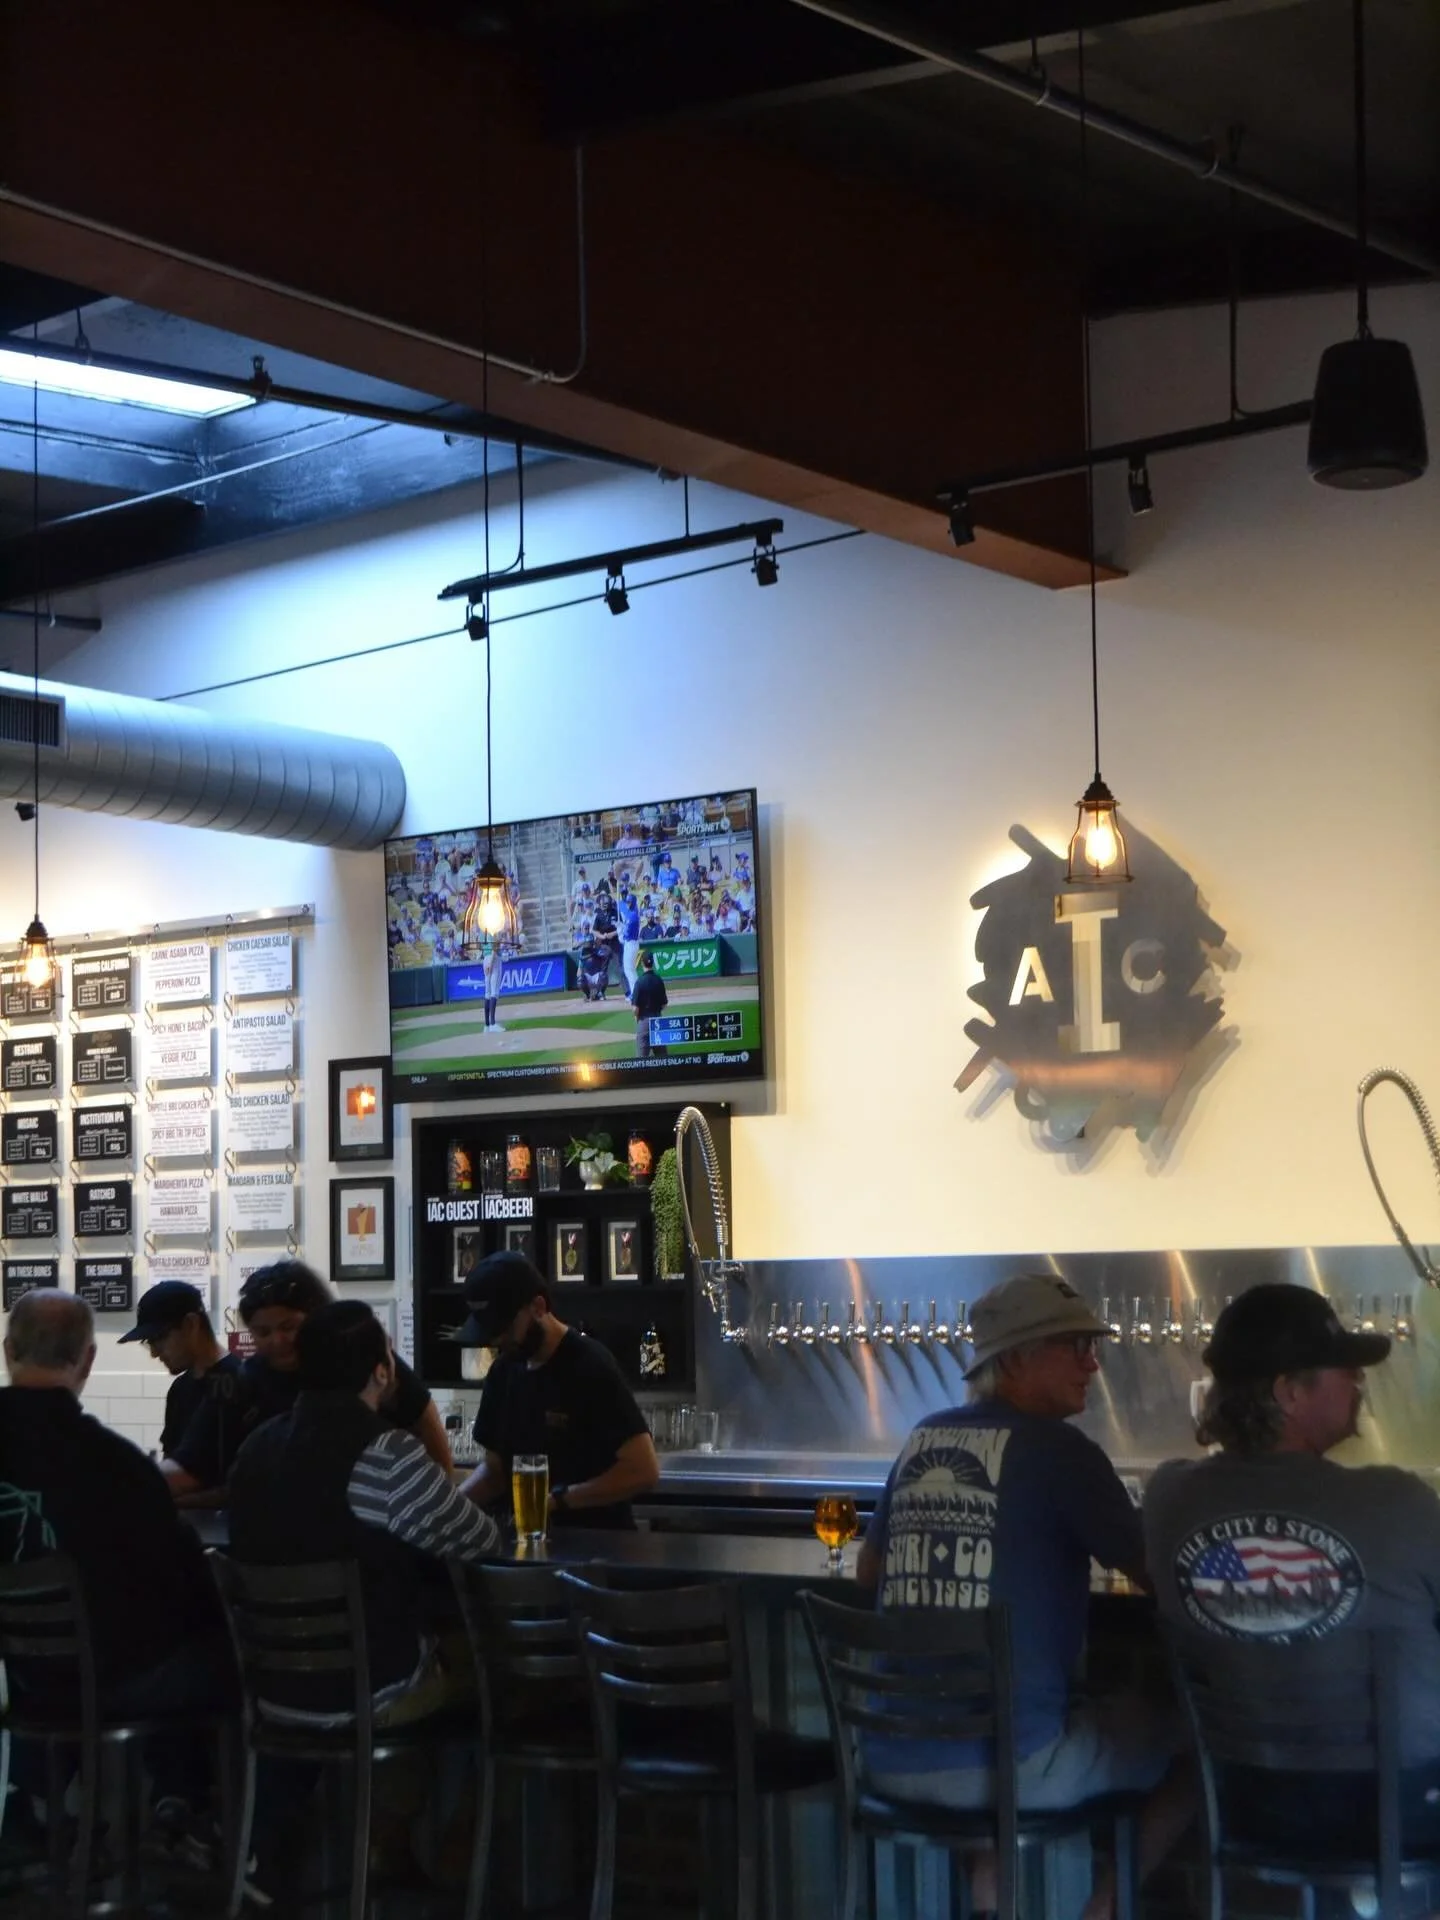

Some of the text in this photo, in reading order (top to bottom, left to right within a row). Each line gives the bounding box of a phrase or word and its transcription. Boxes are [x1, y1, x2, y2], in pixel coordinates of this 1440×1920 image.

[676, 823, 720, 836] SPORTSNET
[228, 940, 250, 952] CHICKEN
[272, 935, 290, 947] SALAD
[188, 946, 204, 956] PIZZA
[185, 976, 200, 986] PIZZA
[500, 968, 534, 989] ANA
[233, 1014, 286, 1029] ANTIPASTO SALAD
[669, 1019, 681, 1028] SEA
[168, 1023, 186, 1033] HONEY
[669, 1033, 682, 1041] LAD
[181, 1050, 196, 1061] PIZZA
[707, 1053, 741, 1064] SPORTSNET
[487, 1070, 514, 1079] SPECTRUM
[514, 1067, 545, 1077] CUSTOMERS
[546, 1066, 560, 1074] WITH
[617, 1060, 645, 1070] ACCOUNTS
[646, 1058, 667, 1068] RECEIVE
[230, 1093, 290, 1108] BBQ CHICKEN SALAD
[80, 1111, 124, 1126] INSTITUTION IPA
[192, 1127, 206, 1138] PIZZA
[189, 1178, 204, 1188] PIZZA
[262, 1174, 274, 1185] FETA
[275, 1173, 293, 1185] SALAD
[184, 1204, 198, 1216] PIZZA
[427, 1200, 480, 1222] IAC GUEST
[485, 1196, 533, 1220] IACBEER!
[172, 1256, 194, 1267] CHICKEN
[194, 1255, 209, 1266] PIZZA
[86, 1264, 96, 1276] THE
[1177, 1516, 1351, 1570] TILE CITY & STONE
[955, 1535, 993, 1580] CO
